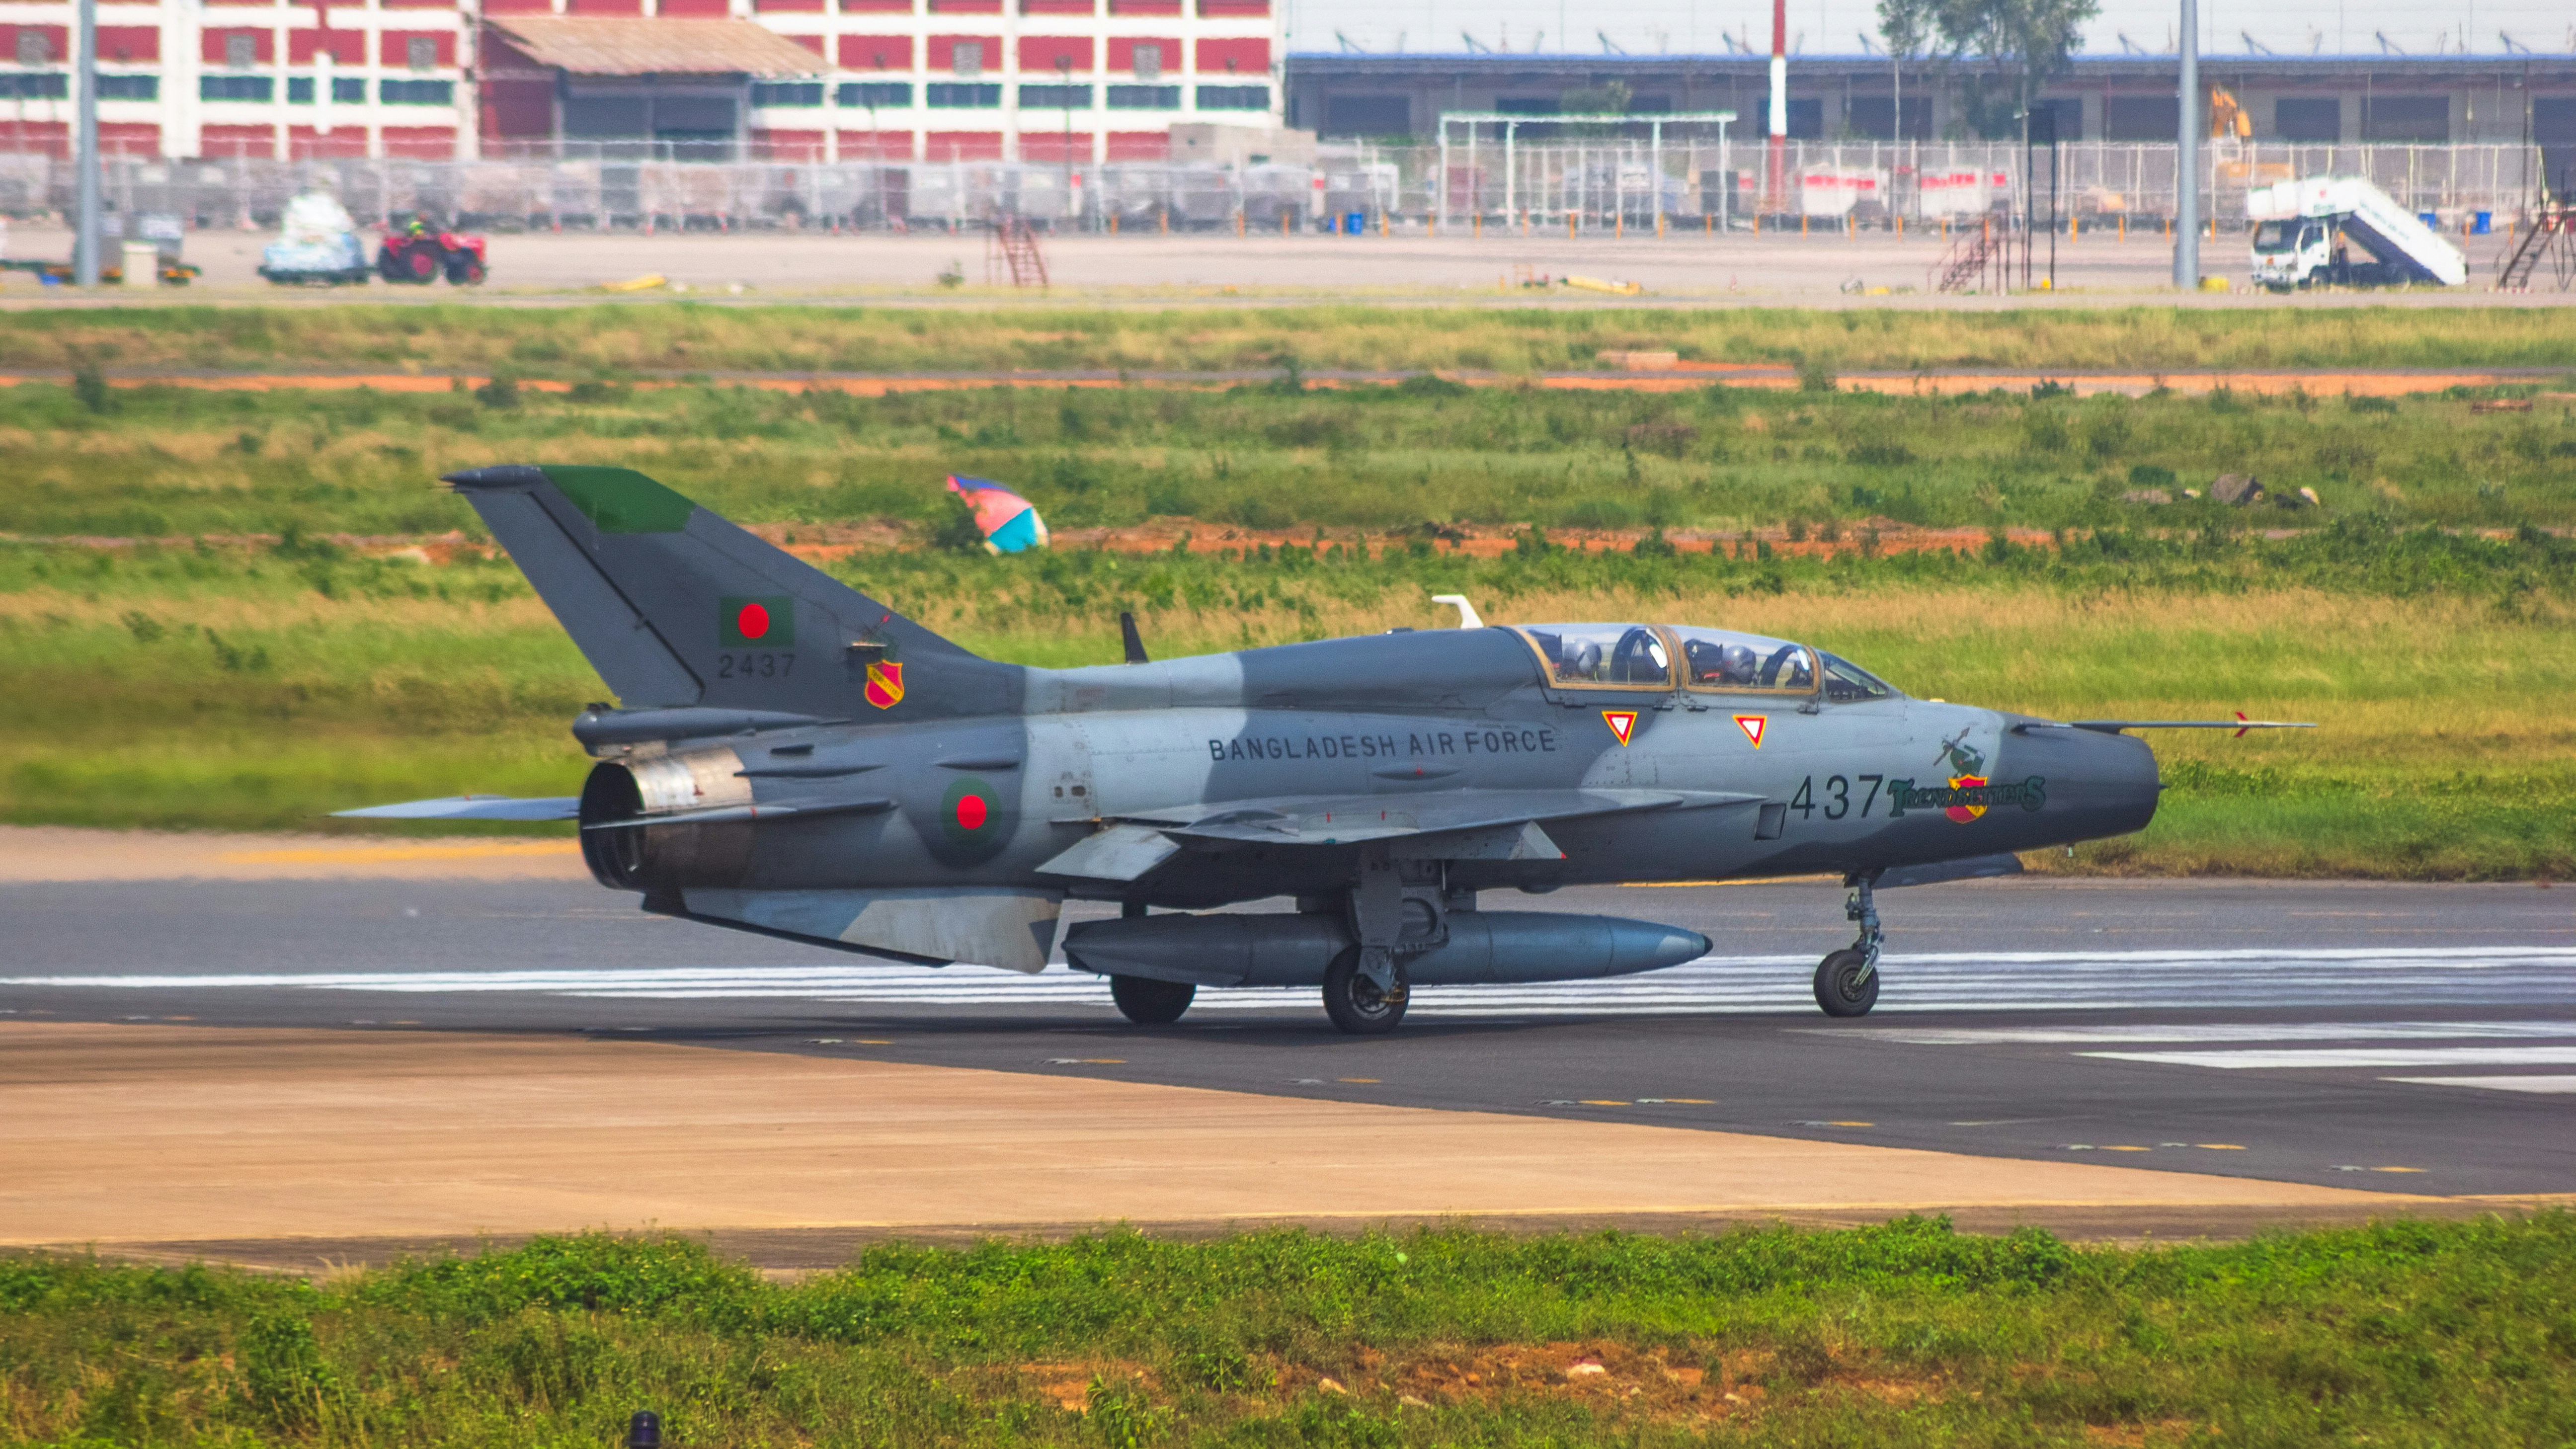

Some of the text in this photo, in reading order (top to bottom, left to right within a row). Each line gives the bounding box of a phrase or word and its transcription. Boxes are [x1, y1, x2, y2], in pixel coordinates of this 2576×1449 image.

[719, 654, 795, 679] 2437
[1209, 729, 1556, 761] BANGLADESH AIR FORCE
[1790, 775, 1883, 820] 437
